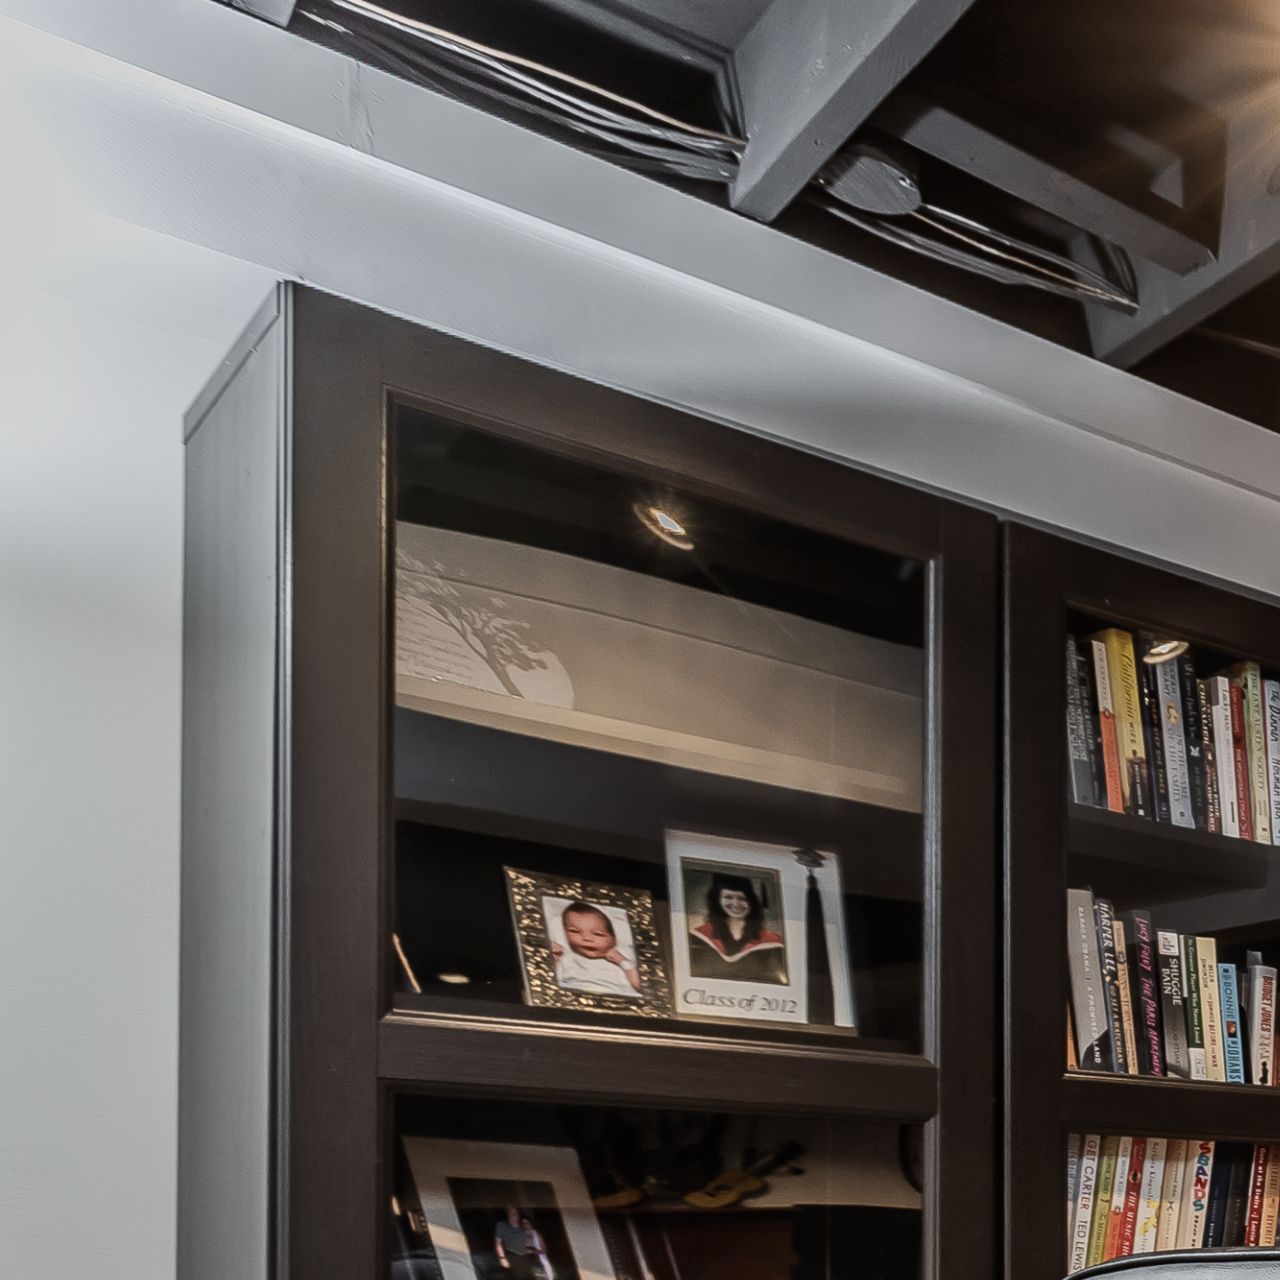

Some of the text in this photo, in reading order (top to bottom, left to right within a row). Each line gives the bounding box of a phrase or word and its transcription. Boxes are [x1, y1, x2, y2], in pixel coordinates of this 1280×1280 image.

[1122, 654, 1132, 718] California
[1271, 705, 1280, 742] Dinner
[1257, 756, 1265, 791] SOCIETY
[1099, 902, 1113, 948] HARPER
[1135, 917, 1152, 973] LUCY FOLEY
[683, 988, 798, 1014] Class of 2012
[1140, 977, 1153, 995] THE
[1161, 958, 1182, 1006] SHUGGIE BAIN
[1223, 981, 1234, 1019] BONNIE
[1262, 976, 1273, 1007] BRIDGET
[1141, 997, 1158, 1026] PARIS
[1261, 1007, 1272, 1032] JONES
[1093, 1040, 1101, 1064] LAND
[1113, 1021, 1123, 1064] WATCHMAN
[1081, 1140, 1097, 1210] GET CARTER
[1124, 1191, 1136, 1238] THE MUSIC
[1073, 1220, 1087, 1270] TED LEWIS
